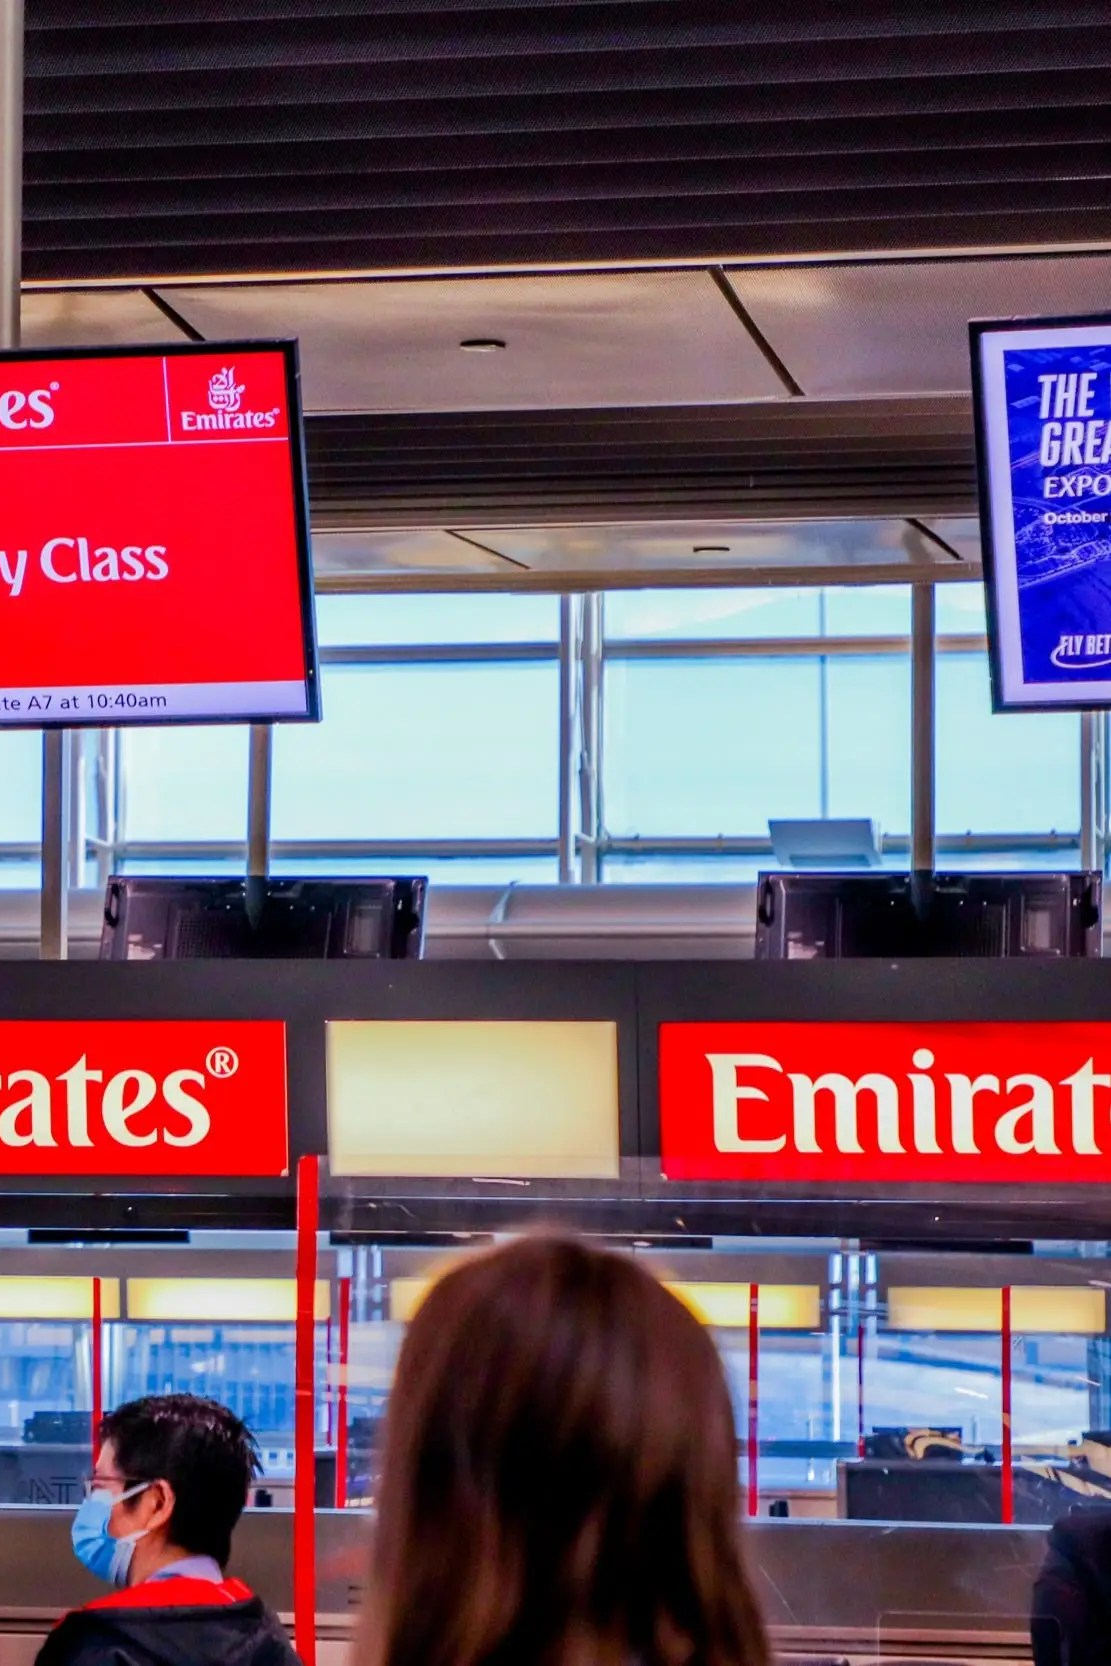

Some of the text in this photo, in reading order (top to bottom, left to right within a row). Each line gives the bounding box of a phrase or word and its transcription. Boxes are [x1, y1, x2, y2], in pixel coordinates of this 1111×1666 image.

[1038, 372, 1098, 419] THE
[1043, 474, 1111, 498] EXPO
[1043, 510, 1109, 525] October
[39, 536, 170, 584] Class
[1058, 634, 1084, 656] FLY
[27, 694, 53, 711] A7
[60, 695, 80, 710] at
[88, 692, 168, 709] 10:40am
[704, 1048, 1111, 1155] Emirat
